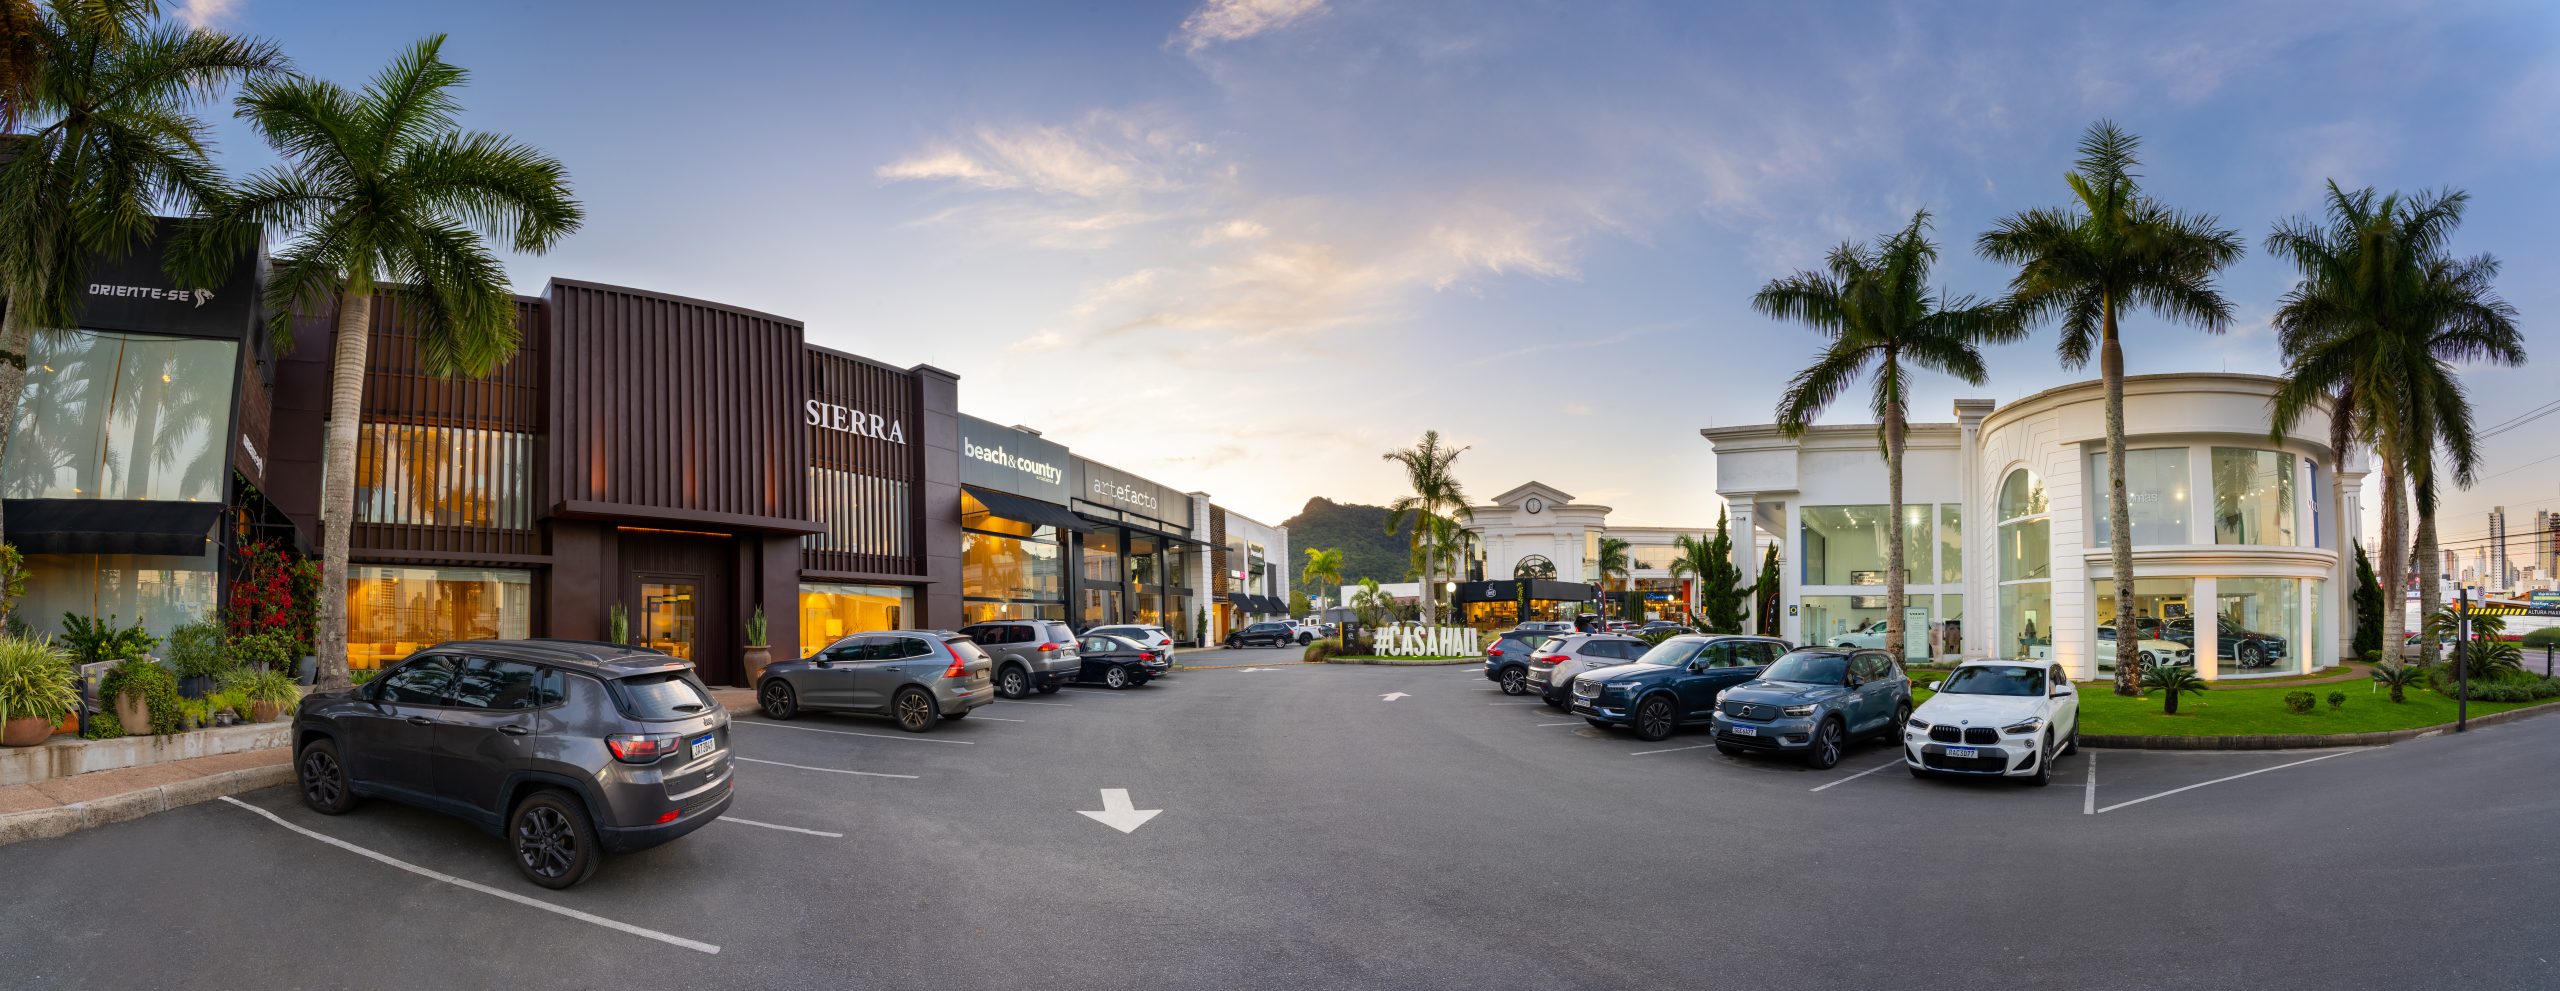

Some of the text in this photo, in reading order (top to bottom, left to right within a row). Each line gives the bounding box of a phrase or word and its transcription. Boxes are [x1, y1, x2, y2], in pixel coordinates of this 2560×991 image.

[89, 283, 190, 302] ORIENTE-SE
[806, 399, 907, 445] SIERRA
[1093, 479, 1157, 510] artefacto
[1372, 626, 1482, 657] #CASAHALL
